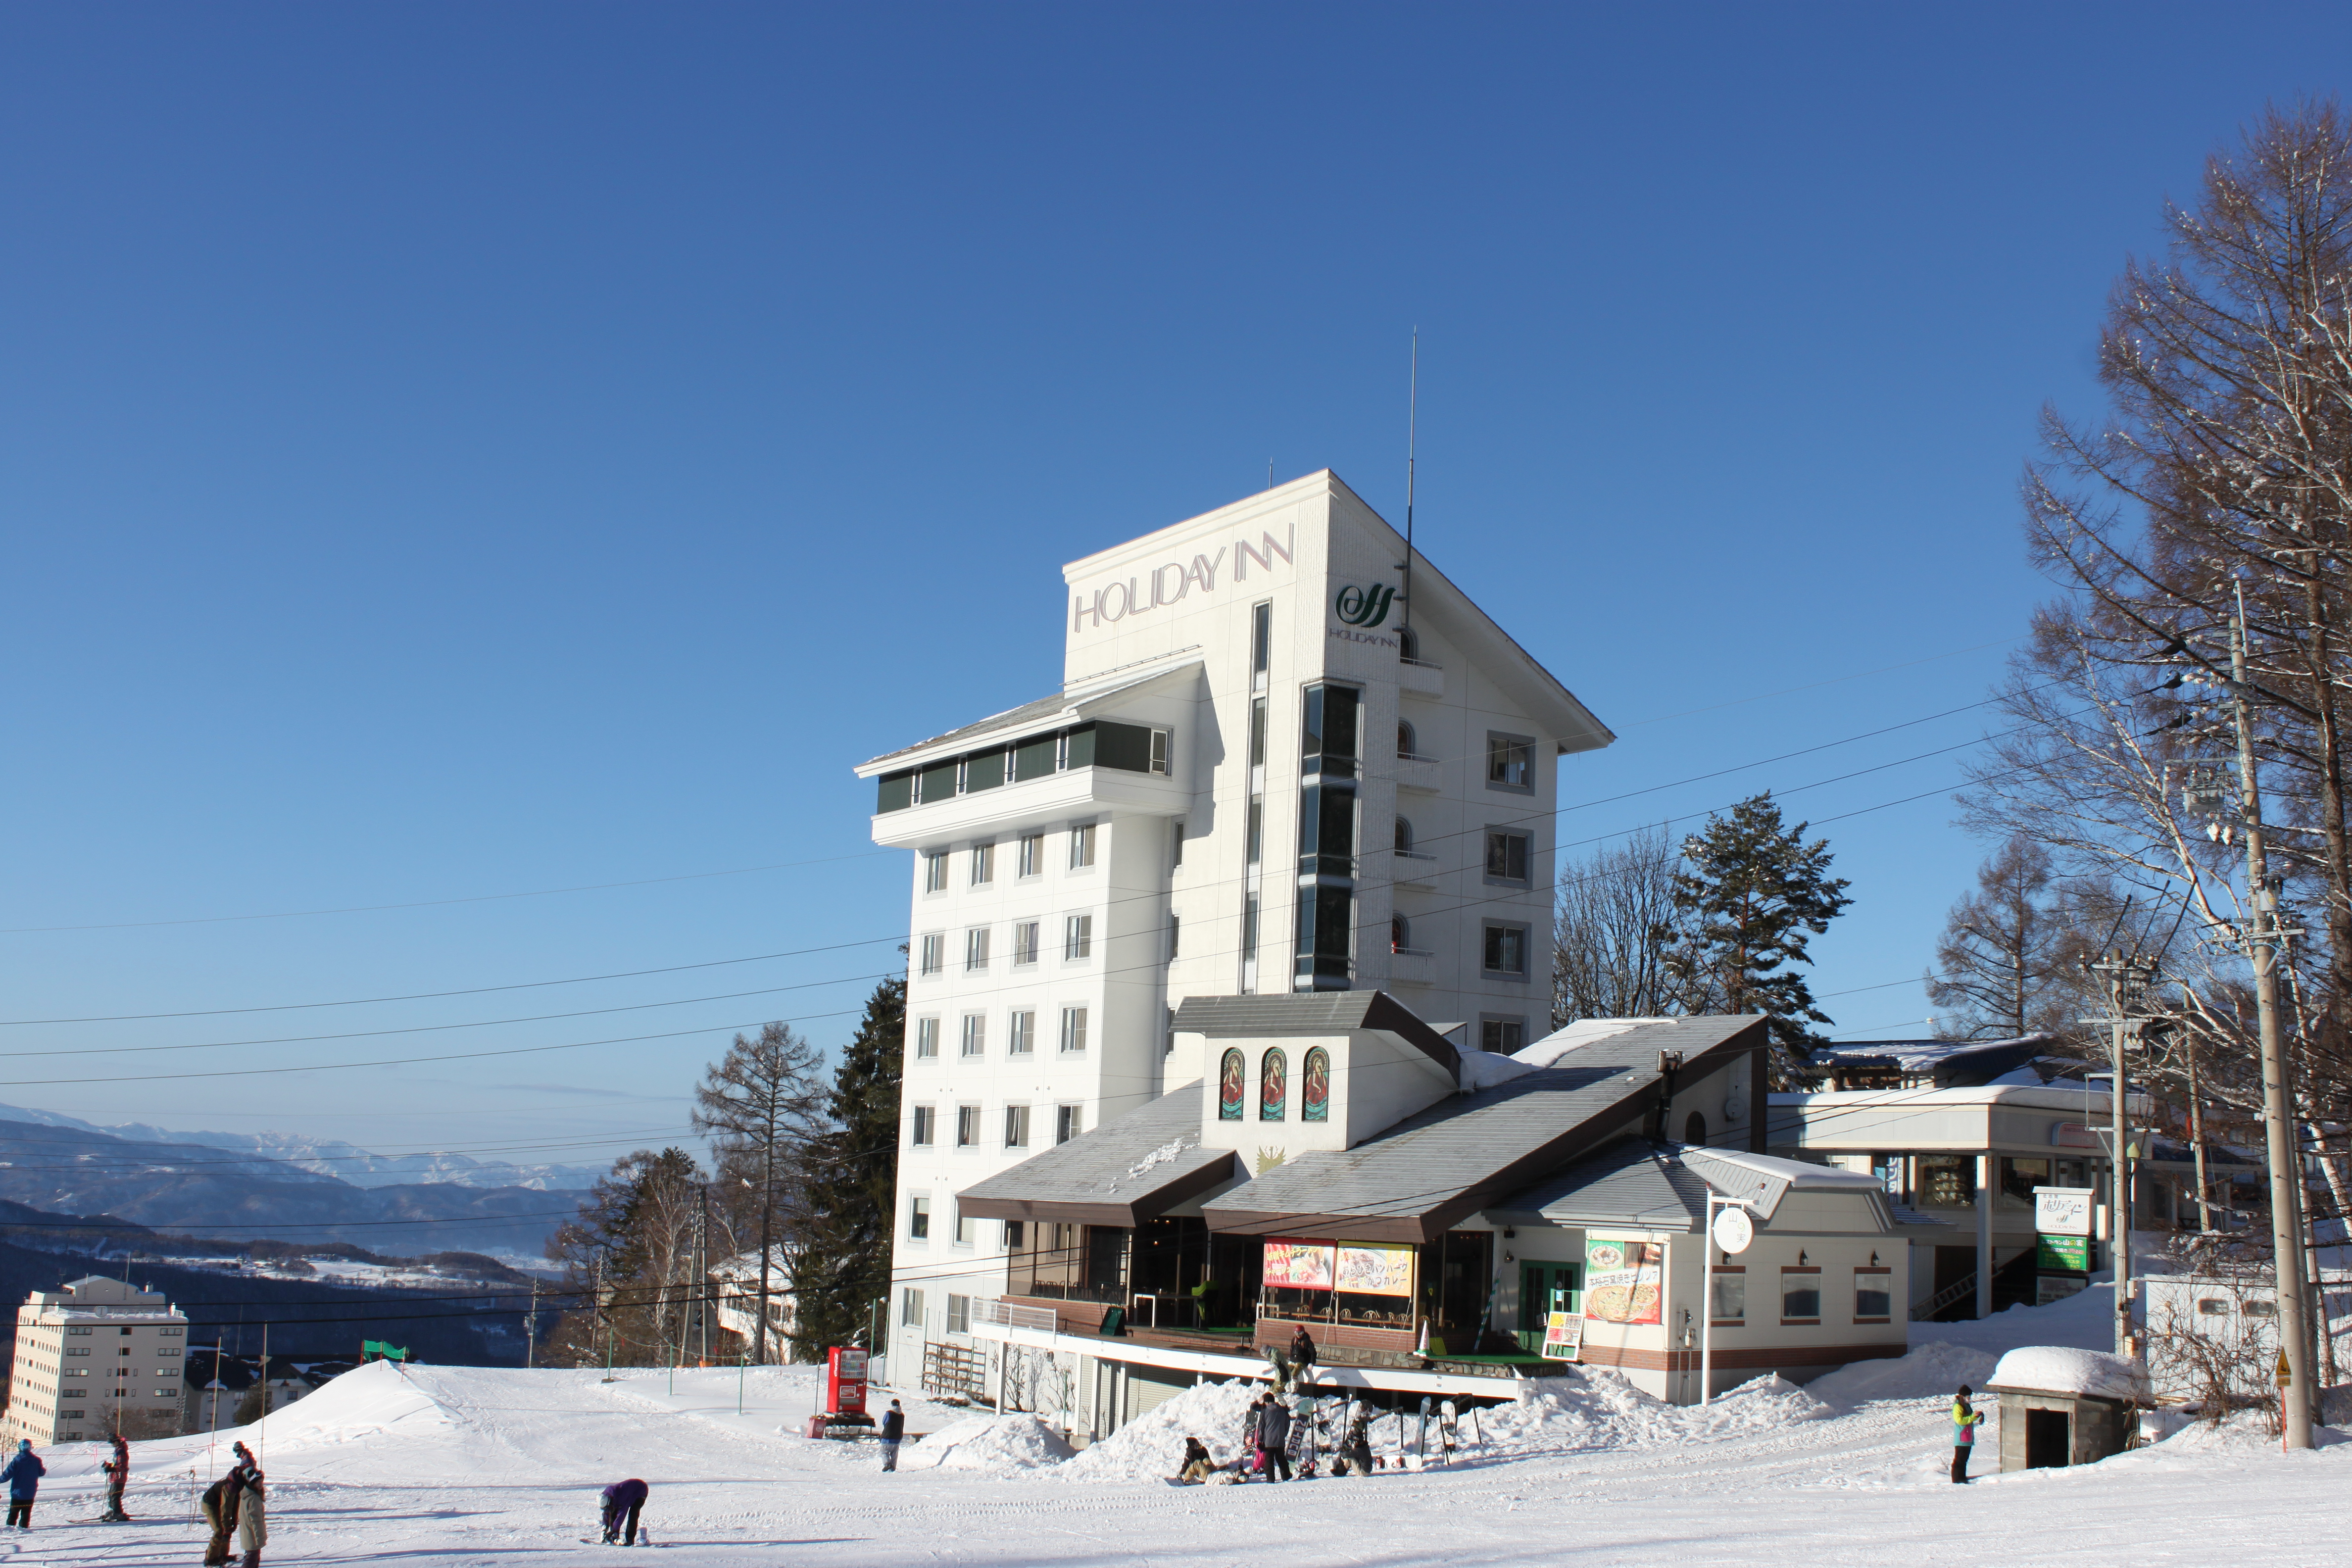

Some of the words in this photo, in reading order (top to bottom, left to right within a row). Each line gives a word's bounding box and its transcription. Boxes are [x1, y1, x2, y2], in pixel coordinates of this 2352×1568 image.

[1074, 546, 1226, 633] HOLIDAY
[1234, 522, 1294, 583] INN
[1329, 628, 1378, 645] HOLIDAY
[1380, 637, 1400, 648] INN
